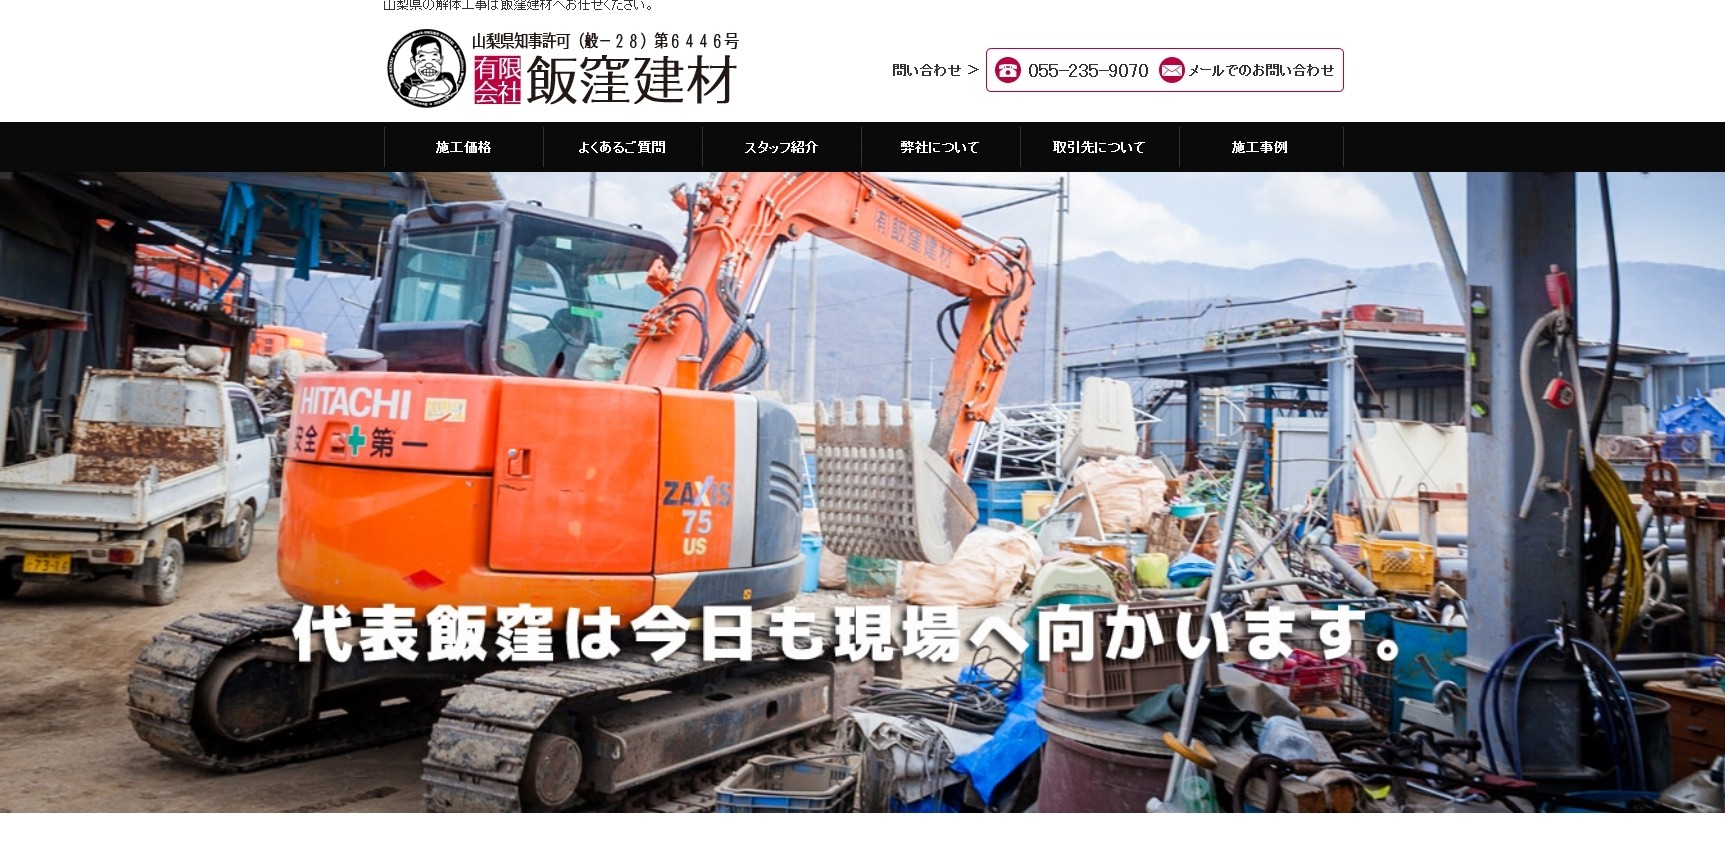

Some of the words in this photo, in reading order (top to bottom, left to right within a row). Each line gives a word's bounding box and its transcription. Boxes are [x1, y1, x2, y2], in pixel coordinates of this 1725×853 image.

[475, 57, 521, 80] 有限
[892, 63, 962, 77] 問い合わせ
[1028, 63, 1149, 78] 055-235-9070
[1187, 63, 1335, 77] メールでのお問い合わせ
[526, 54, 738, 104] 飯窪建材
[475, 81, 521, 104] 会社
[435, 140, 492, 154] 施工価格
[578, 140, 666, 154] よくあるご質問
[744, 140, 819, 154] スタッフ紹介
[900, 140, 983, 154] 弊社について
[1052, 140, 1147, 154] 取引先について
[1231, 140, 1289, 154] 施工事例
[300, 385, 411, 420] HITACHI
[663, 475, 732, 507] ZAXIS
[682, 508, 712, 534] 75
[683, 536, 707, 555] US
